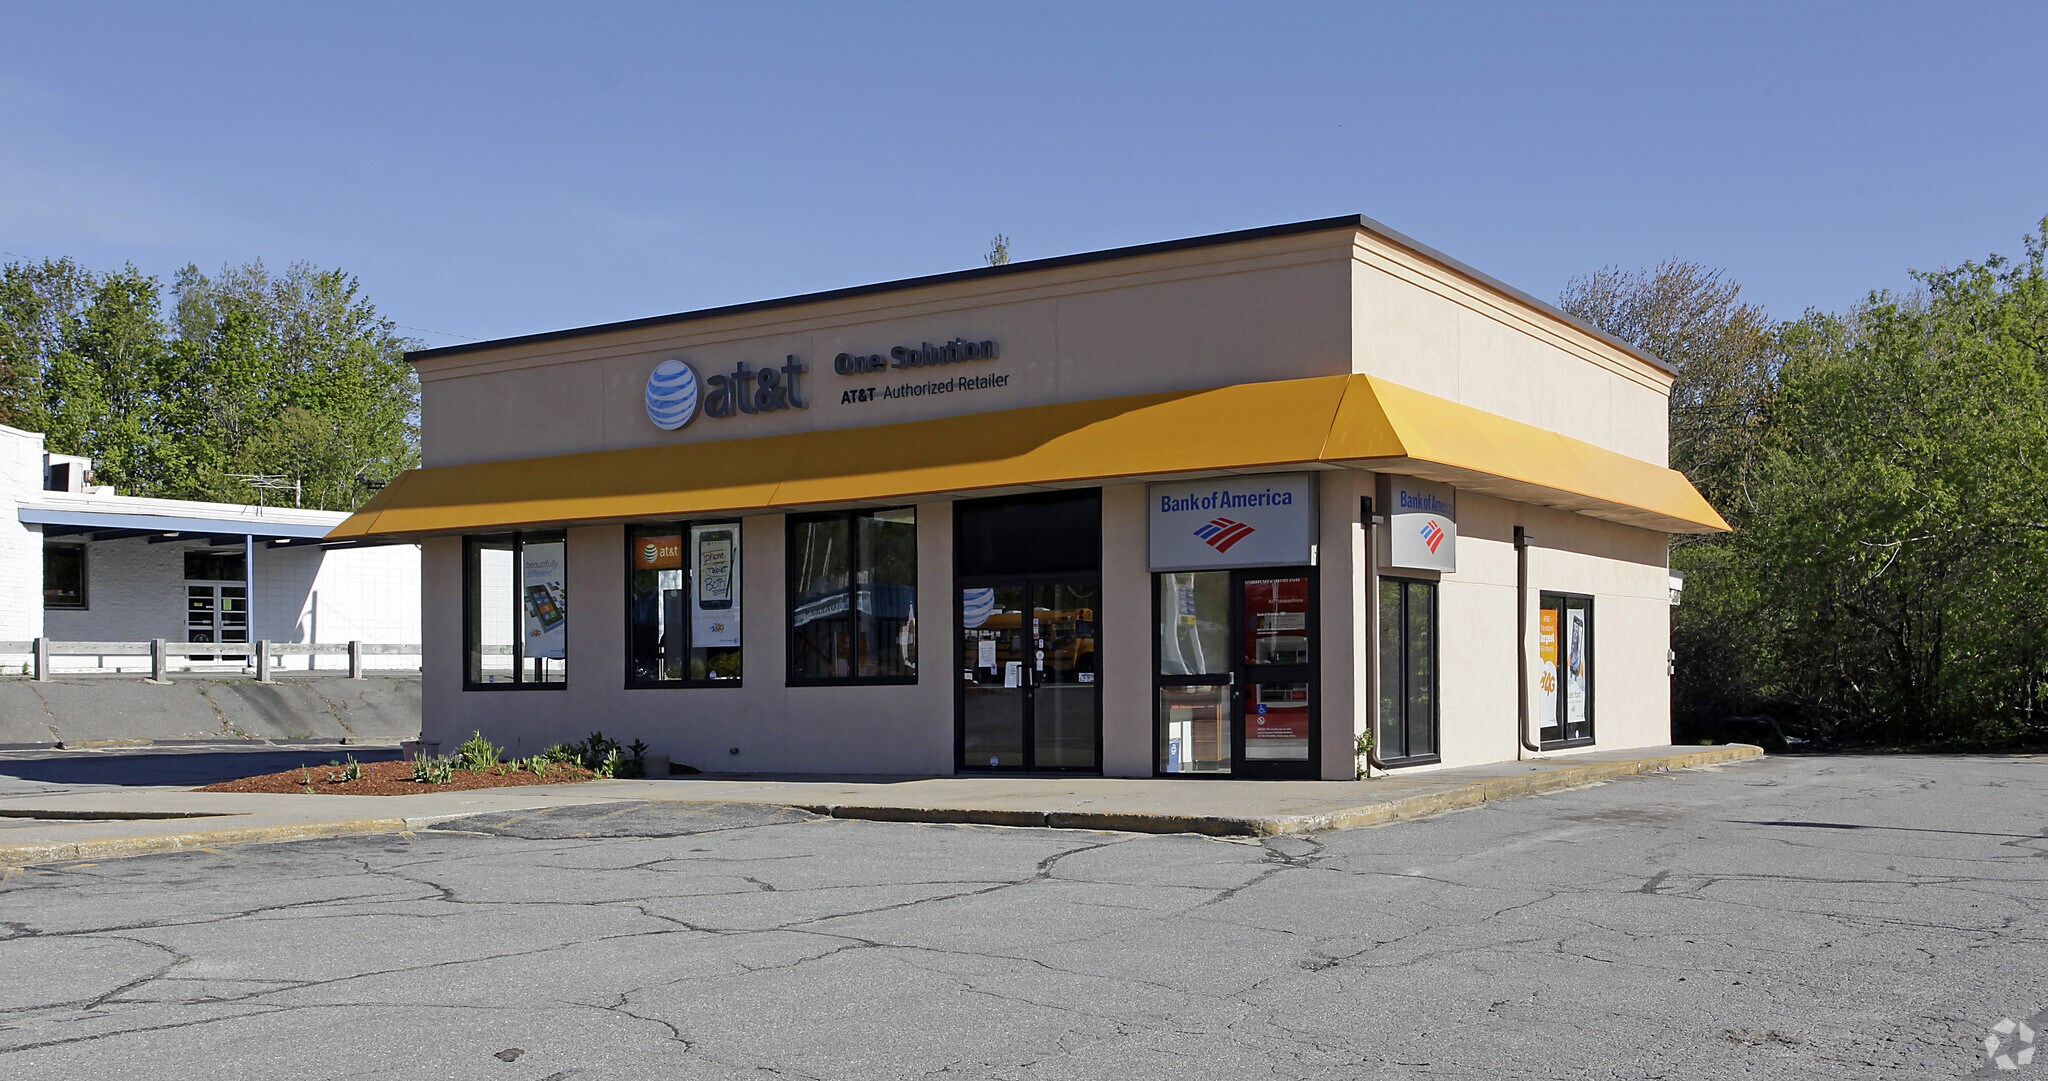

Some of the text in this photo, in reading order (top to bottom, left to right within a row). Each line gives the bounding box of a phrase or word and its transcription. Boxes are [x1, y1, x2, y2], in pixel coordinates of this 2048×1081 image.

[834, 337, 999, 376] One Solution
[704, 354, 809, 418] at&t
[841, 373, 1010, 405] AT&T Authorized Retailer
[1161, 488, 1292, 512] Bank of America
[1400, 490, 1423, 509] Bank
[1423, 494, 1431, 510] of
[660, 545, 679, 557] at&t
